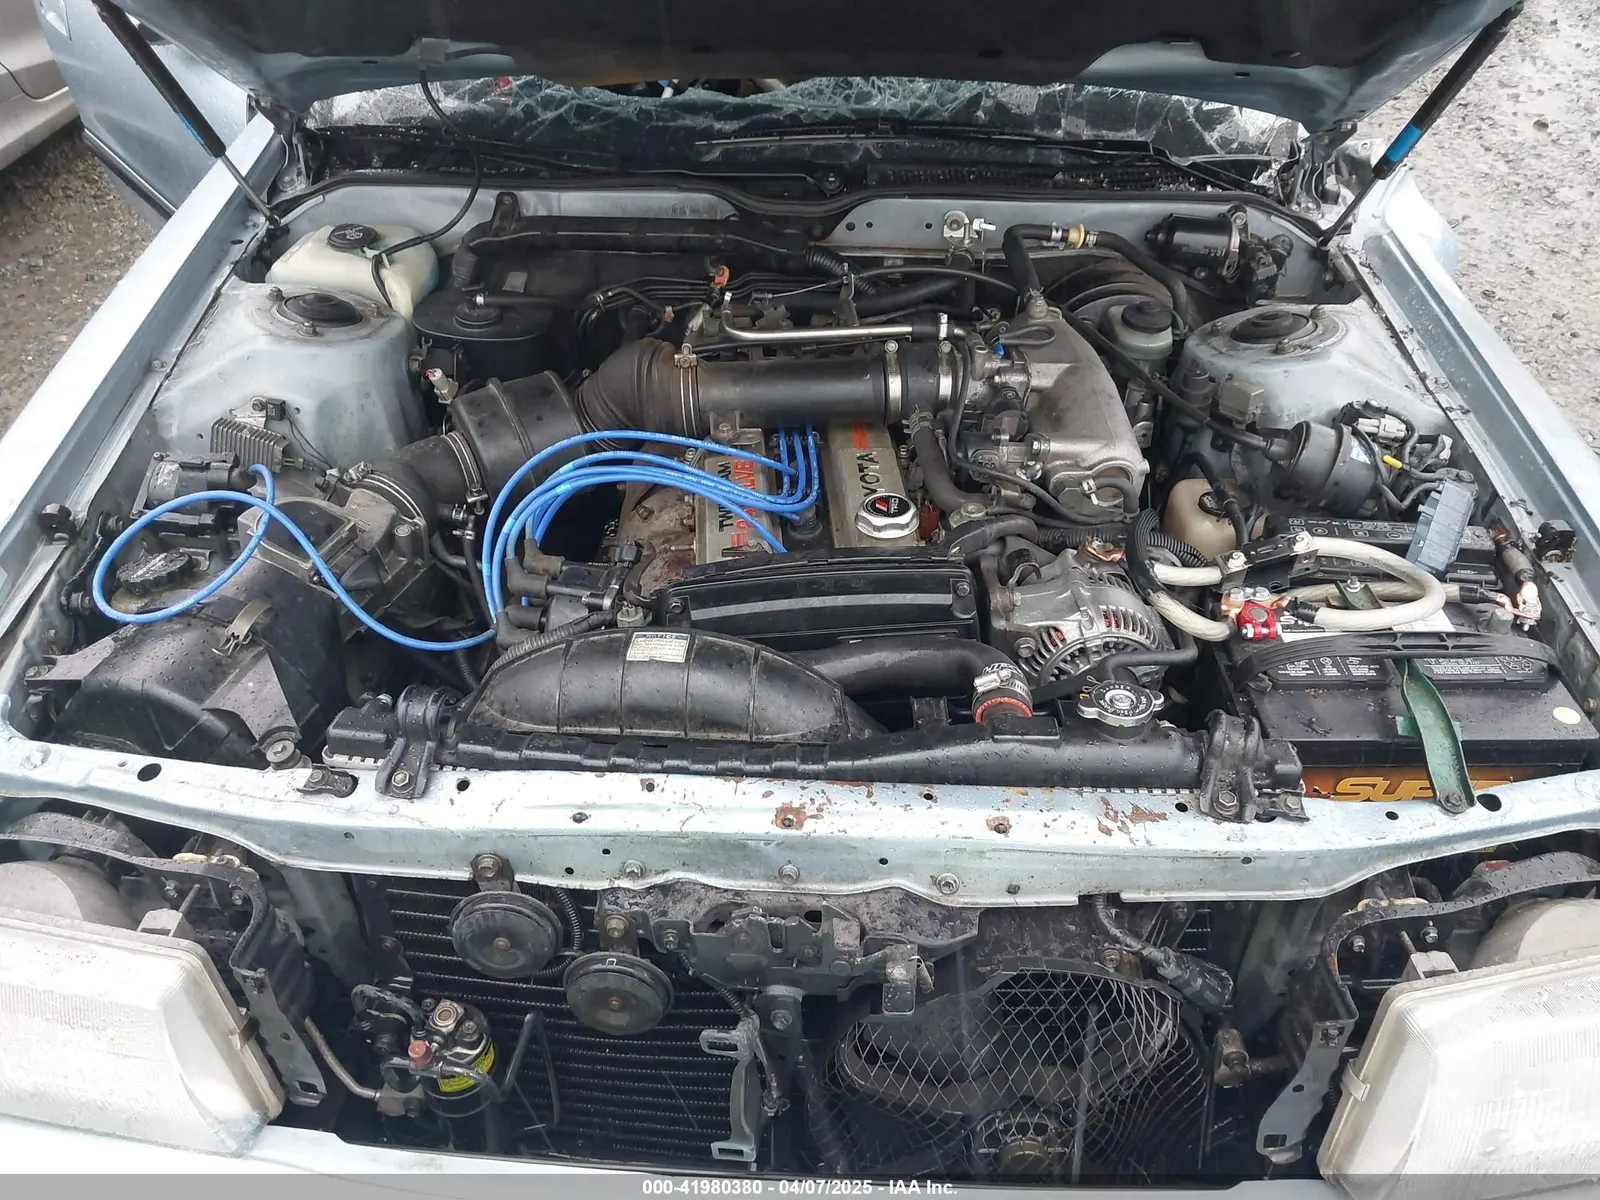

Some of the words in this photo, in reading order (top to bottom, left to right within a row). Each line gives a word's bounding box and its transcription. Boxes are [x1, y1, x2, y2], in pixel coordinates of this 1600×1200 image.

[717, 461, 732, 482] AM
[856, 451, 885, 497] YOTA
[1333, 776, 1512, 802] SUP
